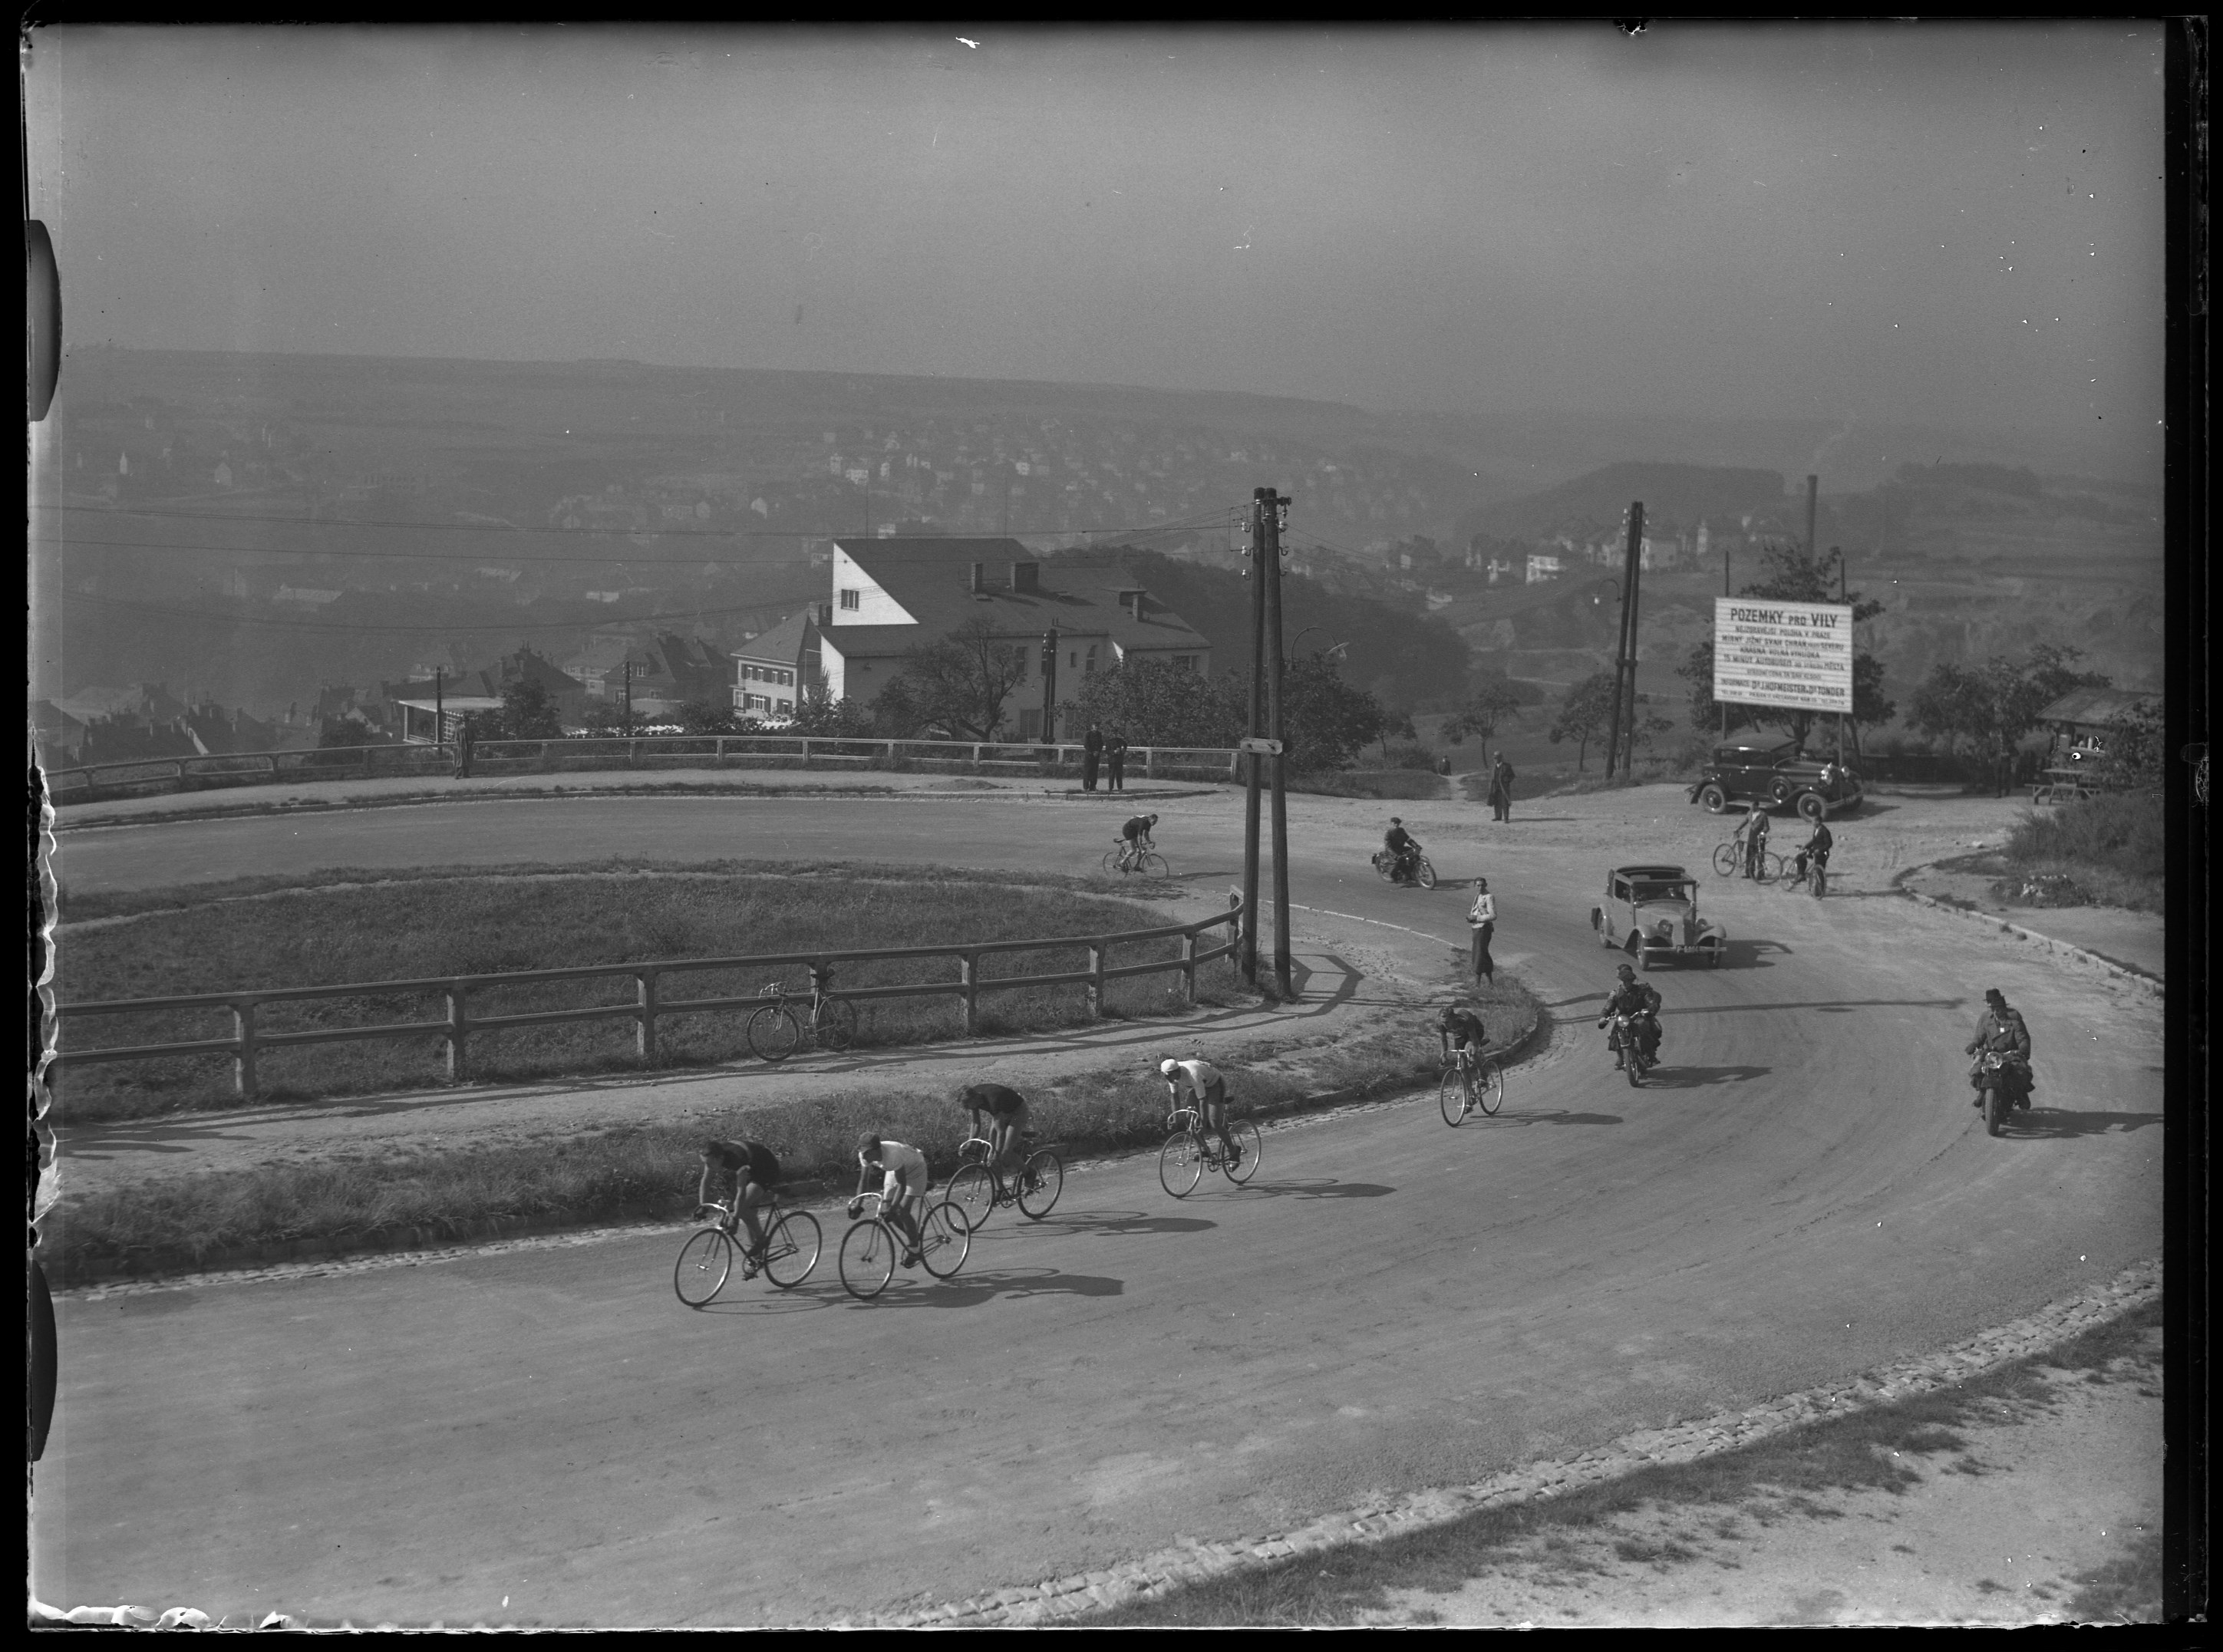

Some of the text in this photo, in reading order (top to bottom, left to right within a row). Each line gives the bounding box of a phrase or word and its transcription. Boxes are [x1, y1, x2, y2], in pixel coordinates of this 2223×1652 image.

[1730, 608, 1837, 628] POZEMKY PRO VILY
